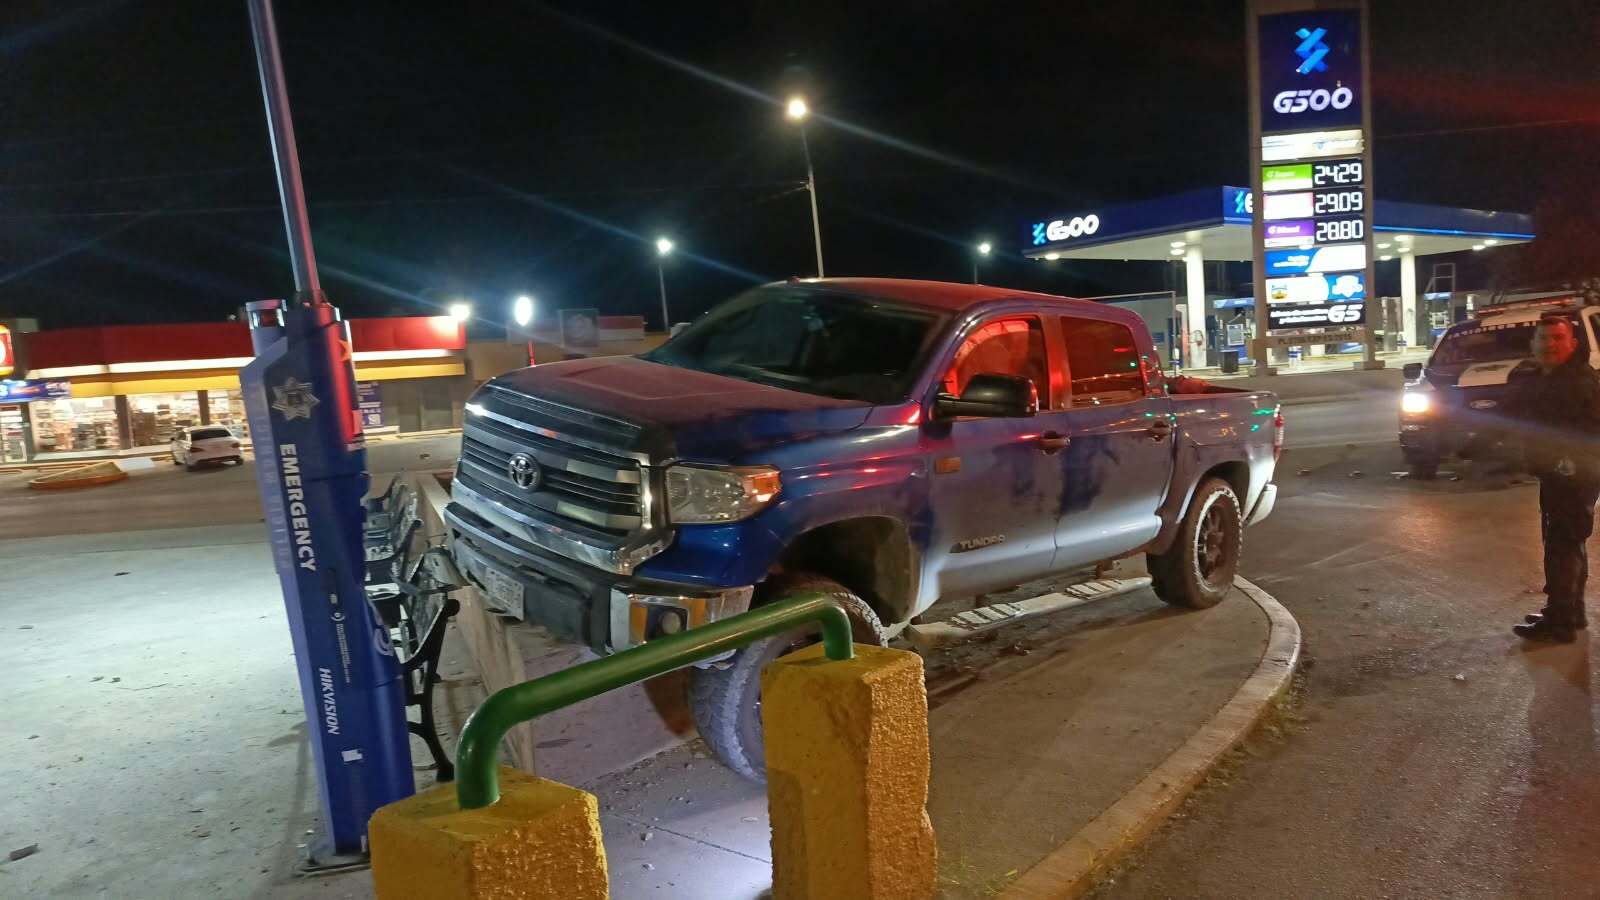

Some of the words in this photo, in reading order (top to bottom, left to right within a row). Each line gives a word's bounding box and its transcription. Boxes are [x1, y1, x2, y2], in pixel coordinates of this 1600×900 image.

[1273, 87, 1353, 114] G500
[1327, 304, 1364, 323] G5
[279, 443, 317, 572] EMERGENCY
[318, 667, 341, 736] HIKVISION
